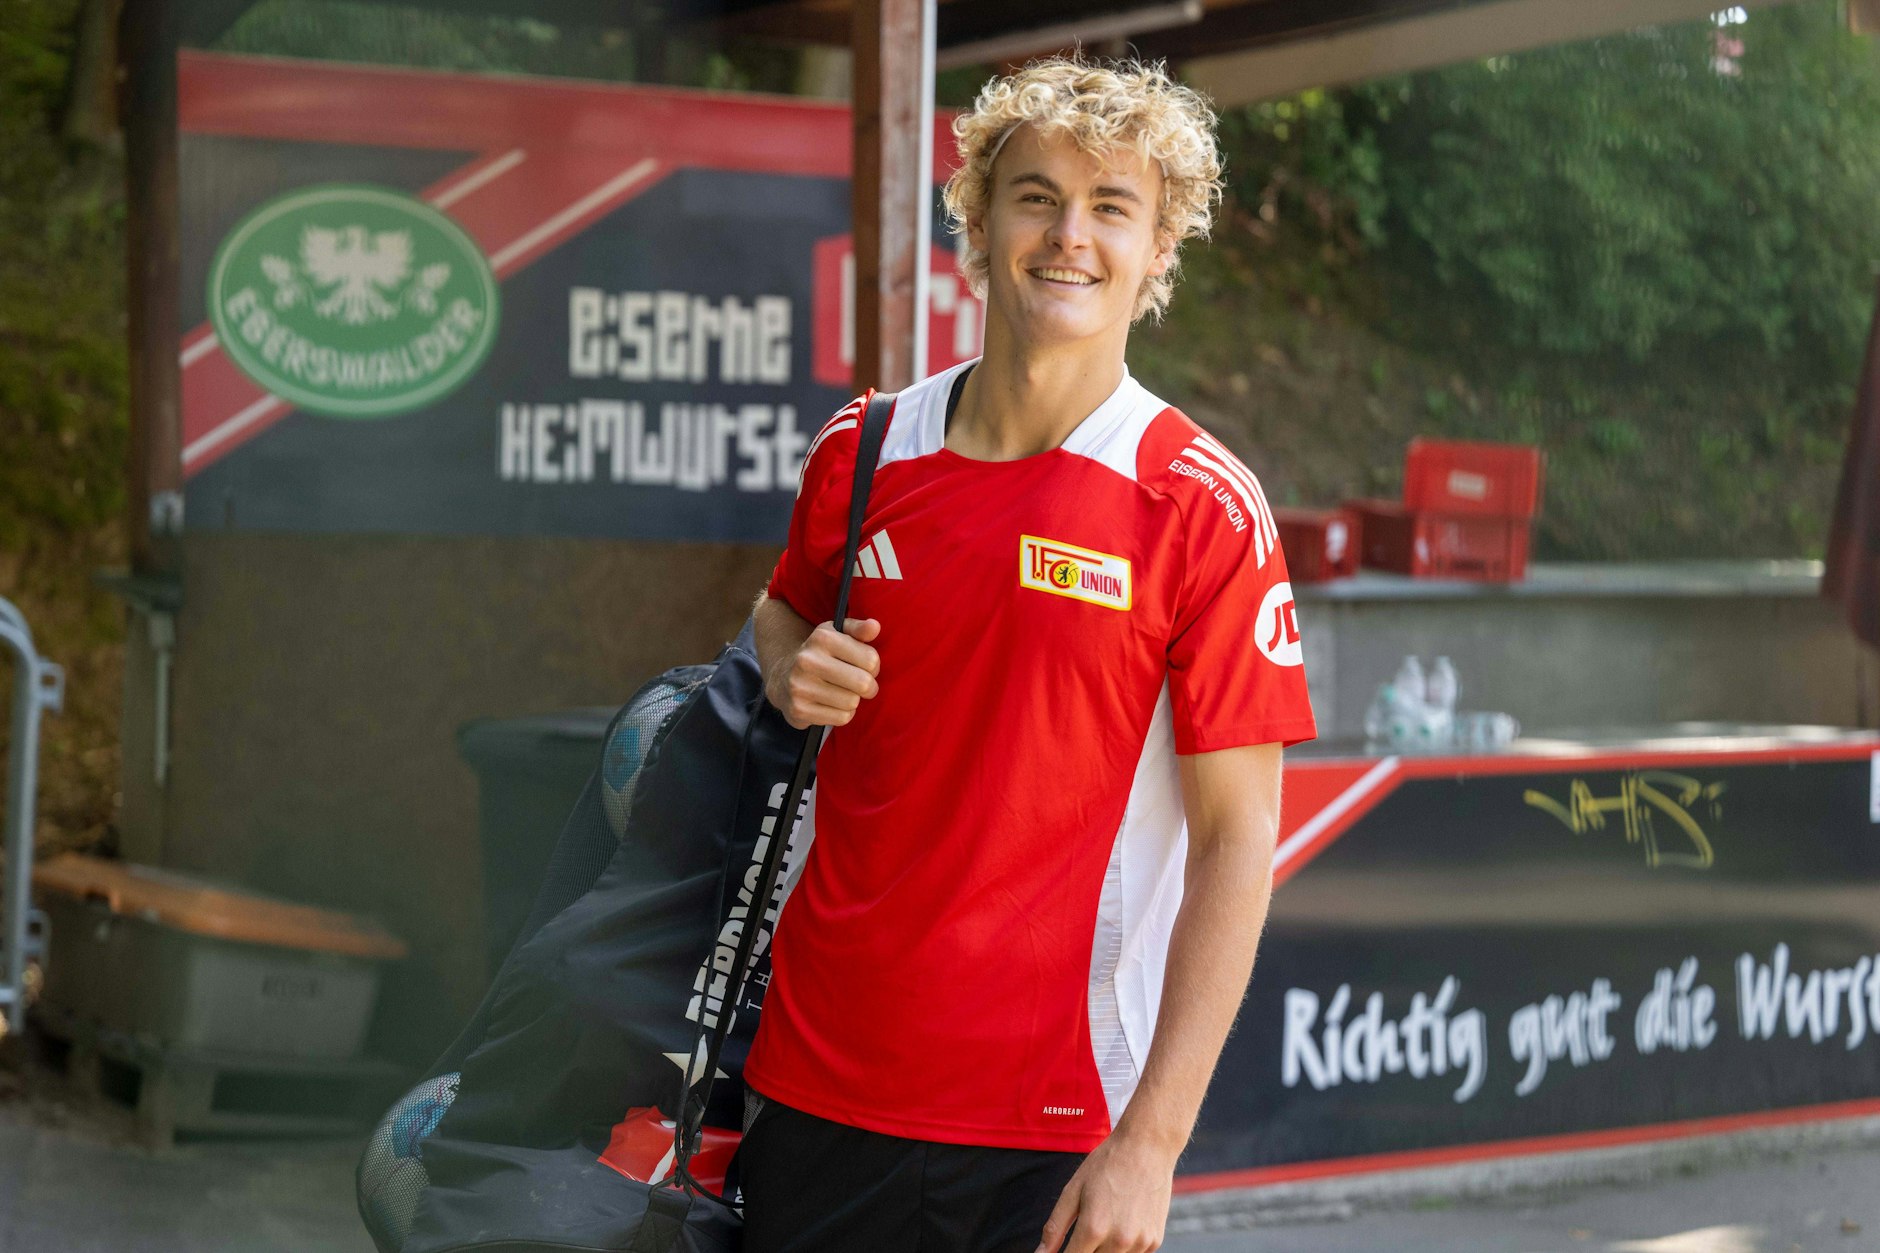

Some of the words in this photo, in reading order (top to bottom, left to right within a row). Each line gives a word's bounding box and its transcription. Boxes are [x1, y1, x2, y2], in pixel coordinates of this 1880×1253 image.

[226, 287, 483, 389] EBERSWALDER
[1168, 459, 1218, 490] EISERN
[1214, 487, 1247, 533] UNION
[1081, 569, 1122, 598] UNION
[1282, 975, 1486, 1103] Richtig
[1508, 977, 1620, 1097] gut
[1635, 956, 1717, 1053] die
[1043, 1106, 1084, 1116] AEROREADY
